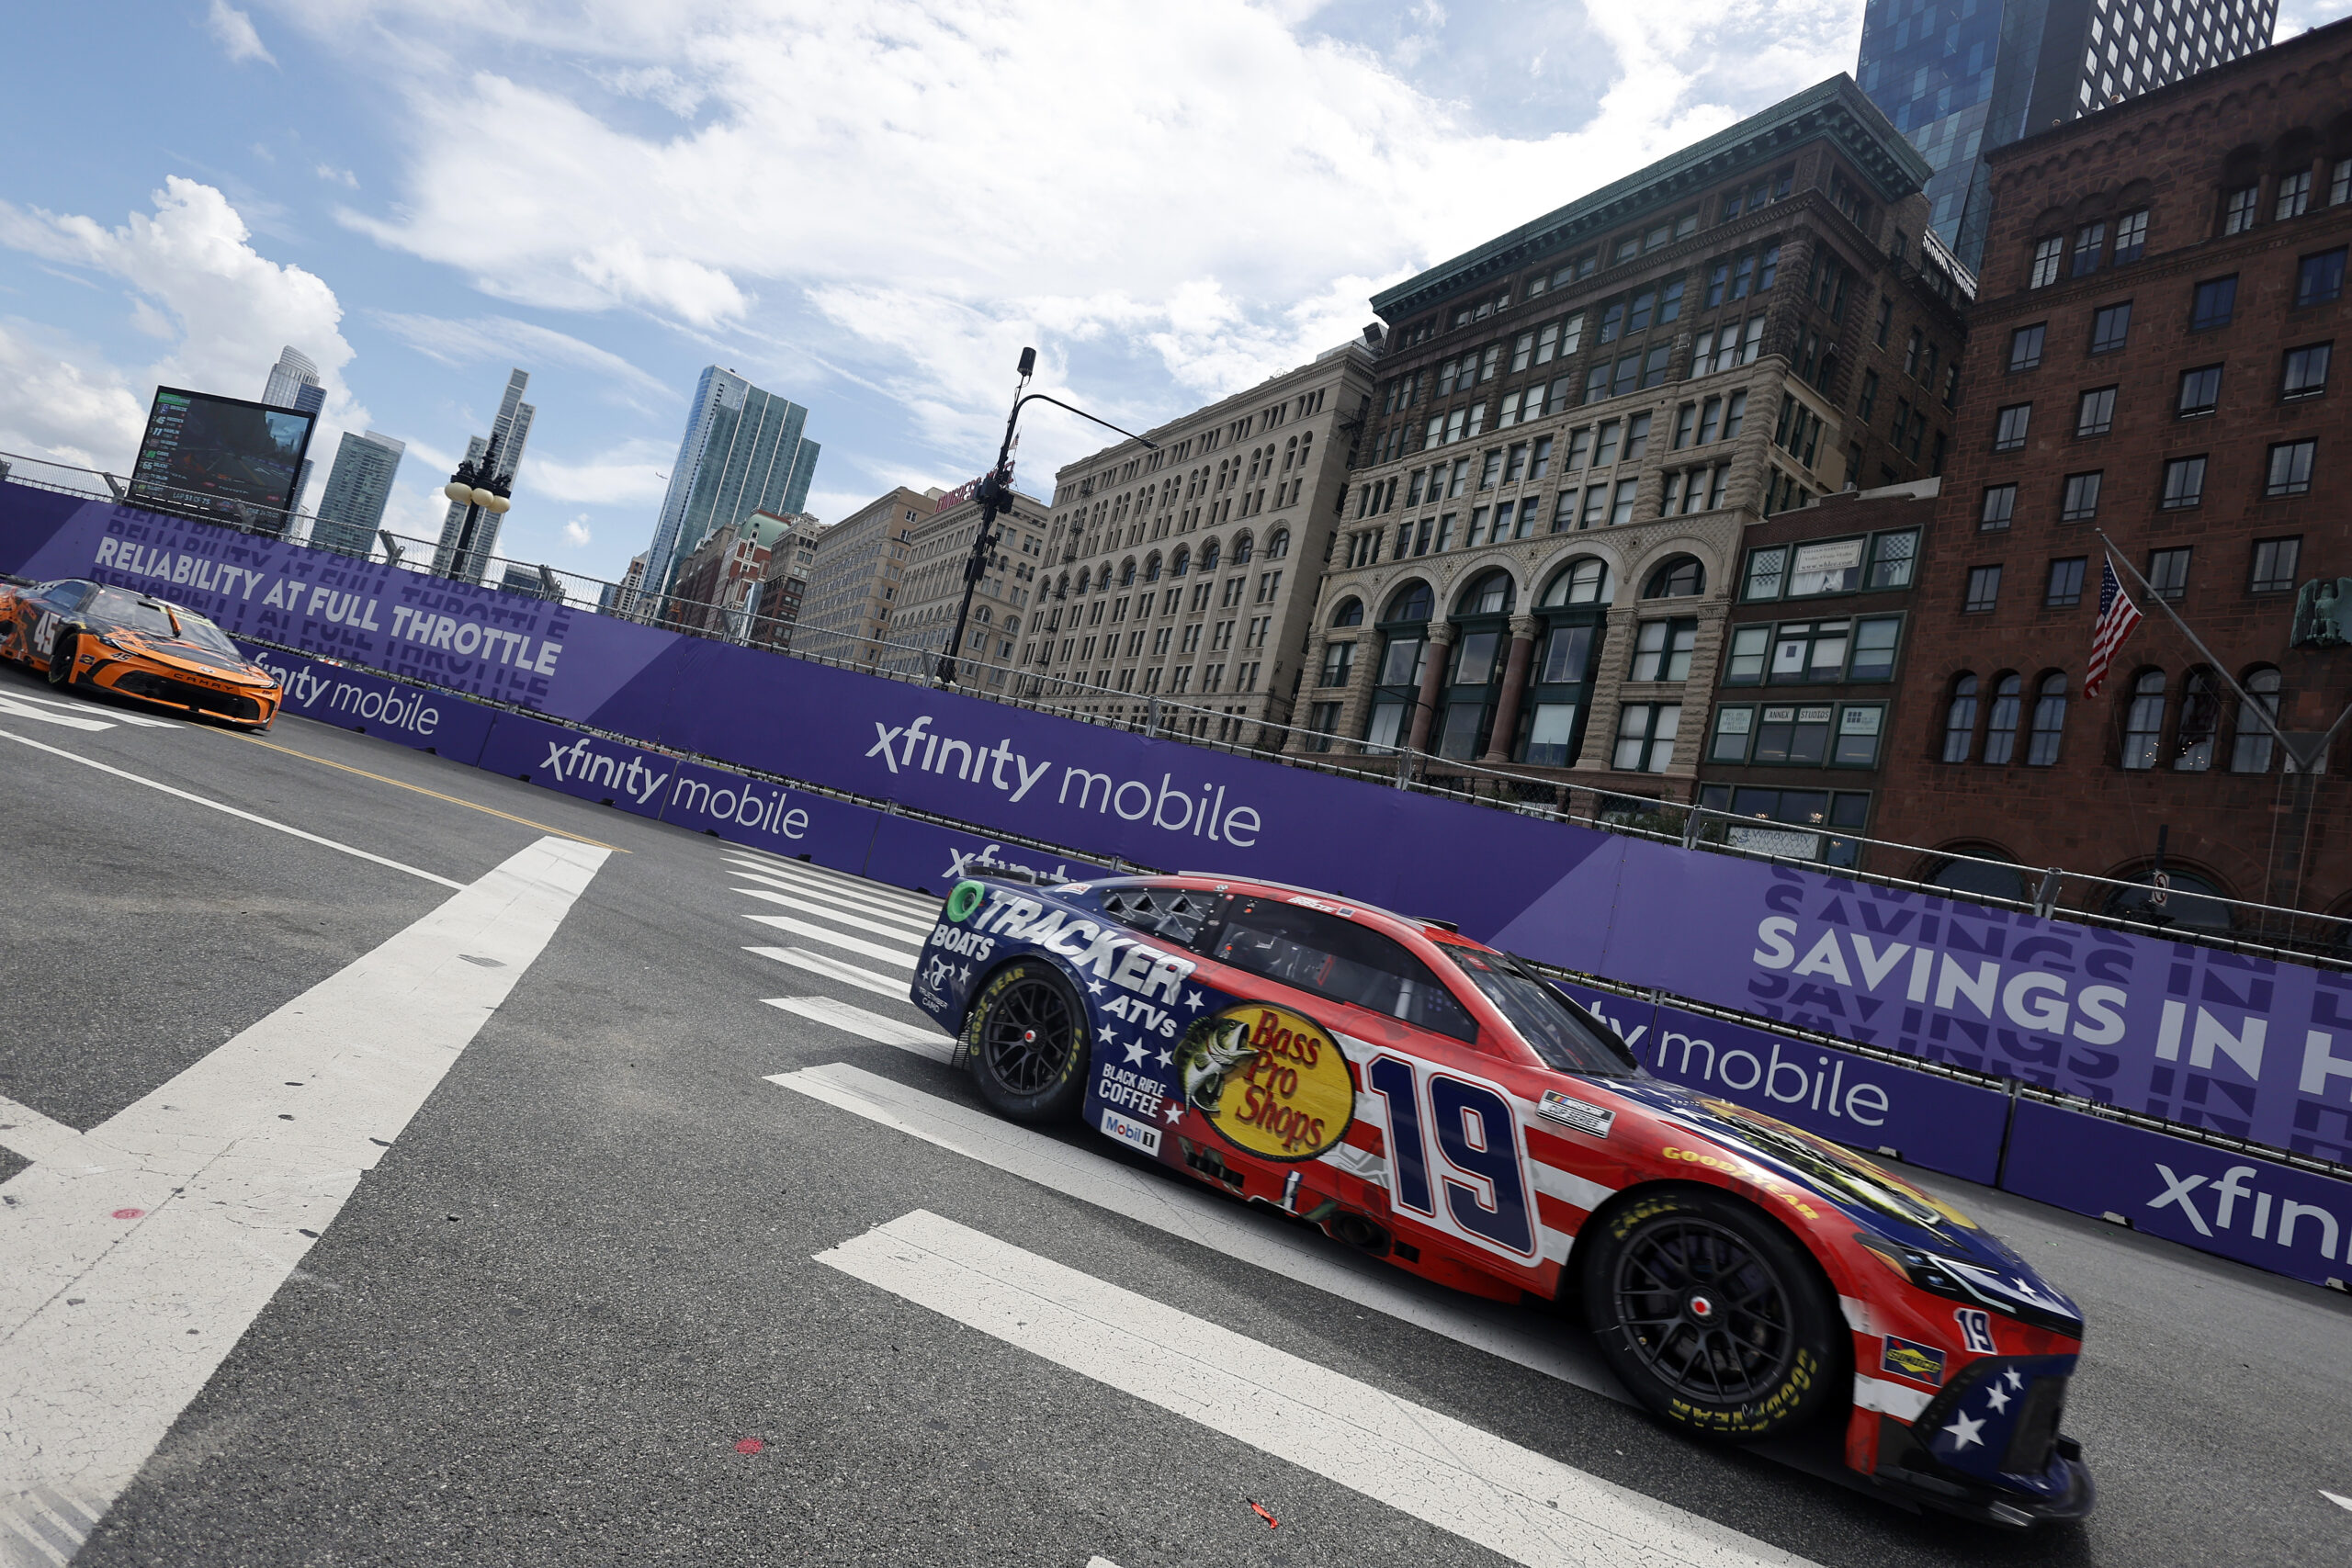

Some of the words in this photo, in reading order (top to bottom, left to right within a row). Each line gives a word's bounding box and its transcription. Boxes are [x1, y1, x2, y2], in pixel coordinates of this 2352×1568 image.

[95, 536, 265, 601] RELIABILITY
[262, 577, 307, 612] AT
[306, 586, 379, 632] FULL
[390, 605, 563, 676] THROTTLE
[33, 611, 61, 655] 45
[110, 651, 135, 662] 45
[174, 672, 235, 692] CAMRY
[330, 682, 439, 735] mobile
[1768, 710, 1790, 719] ANNEX
[1800, 709, 1830, 719] STUDIOS
[539, 739, 668, 804] xfinity
[671, 777, 809, 840] mobile
[865, 716, 1051, 803] xfinity
[1058, 766, 1261, 847] mobile
[1753, 829, 1787, 842] Windy
[930, 923, 996, 962] BOATS
[973, 889, 1197, 1007] TRACKER
[1101, 995, 1178, 1039] ATVs
[1753, 916, 2127, 1045] SAVINGS
[2154, 999, 2267, 1082] IN
[1250, 1010, 1322, 1066] Bass
[1102, 1062, 1138, 1089] BLACK
[1136, 1076, 1168, 1099] RIFLE
[1242, 1047, 1298, 1097] Pro
[1657, 1031, 1889, 1126] mobile
[1098, 1078, 1163, 1119] COFFEE
[1236, 1084, 1326, 1152] Shops
[1105, 1115, 1142, 1144] Mobil
[1367, 1053, 1538, 1259] 19
[1662, 1145, 1821, 1220] GOODYEAR
[1955, 1309, 1996, 1354] 19
